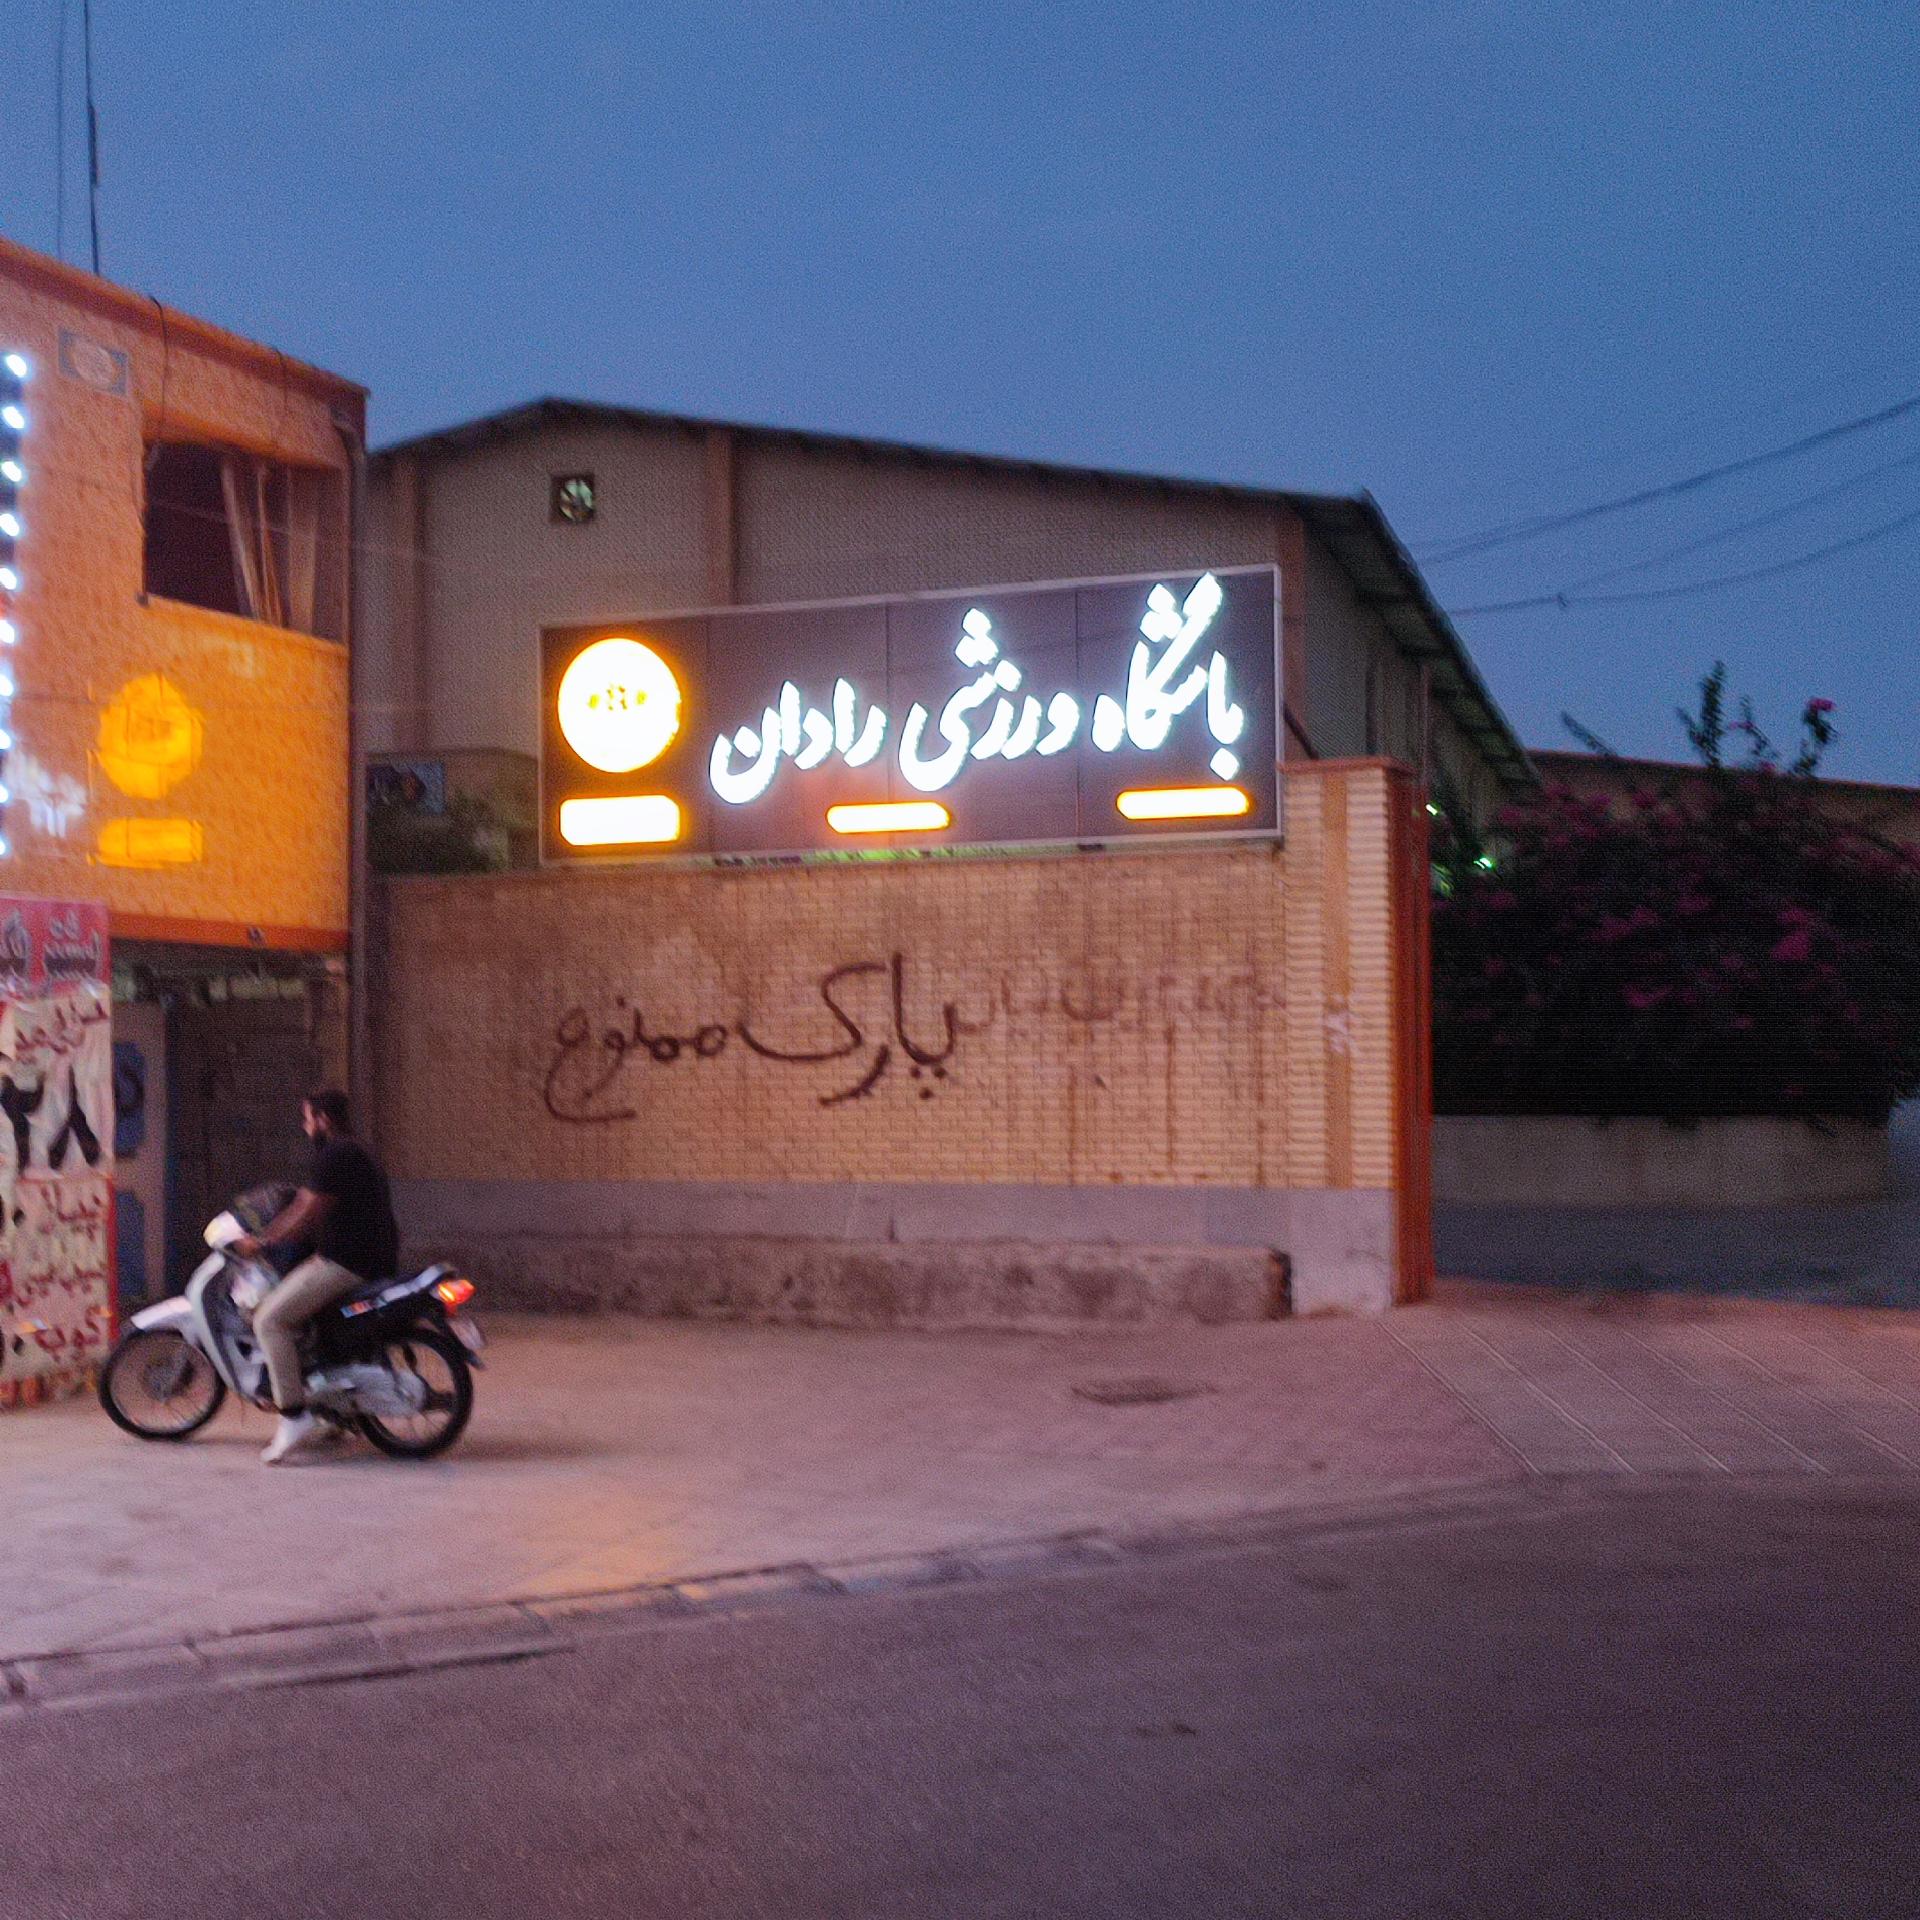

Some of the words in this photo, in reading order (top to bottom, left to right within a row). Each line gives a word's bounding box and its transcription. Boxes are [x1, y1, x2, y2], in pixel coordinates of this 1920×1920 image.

[709, 678, 888, 805] رادان
[898, 607, 1080, 793] ورزشی
[1092, 572, 1246, 782] باشگاه
[543, 996, 728, 1124] ممنوع
[739, 952, 956, 1107] پارک
